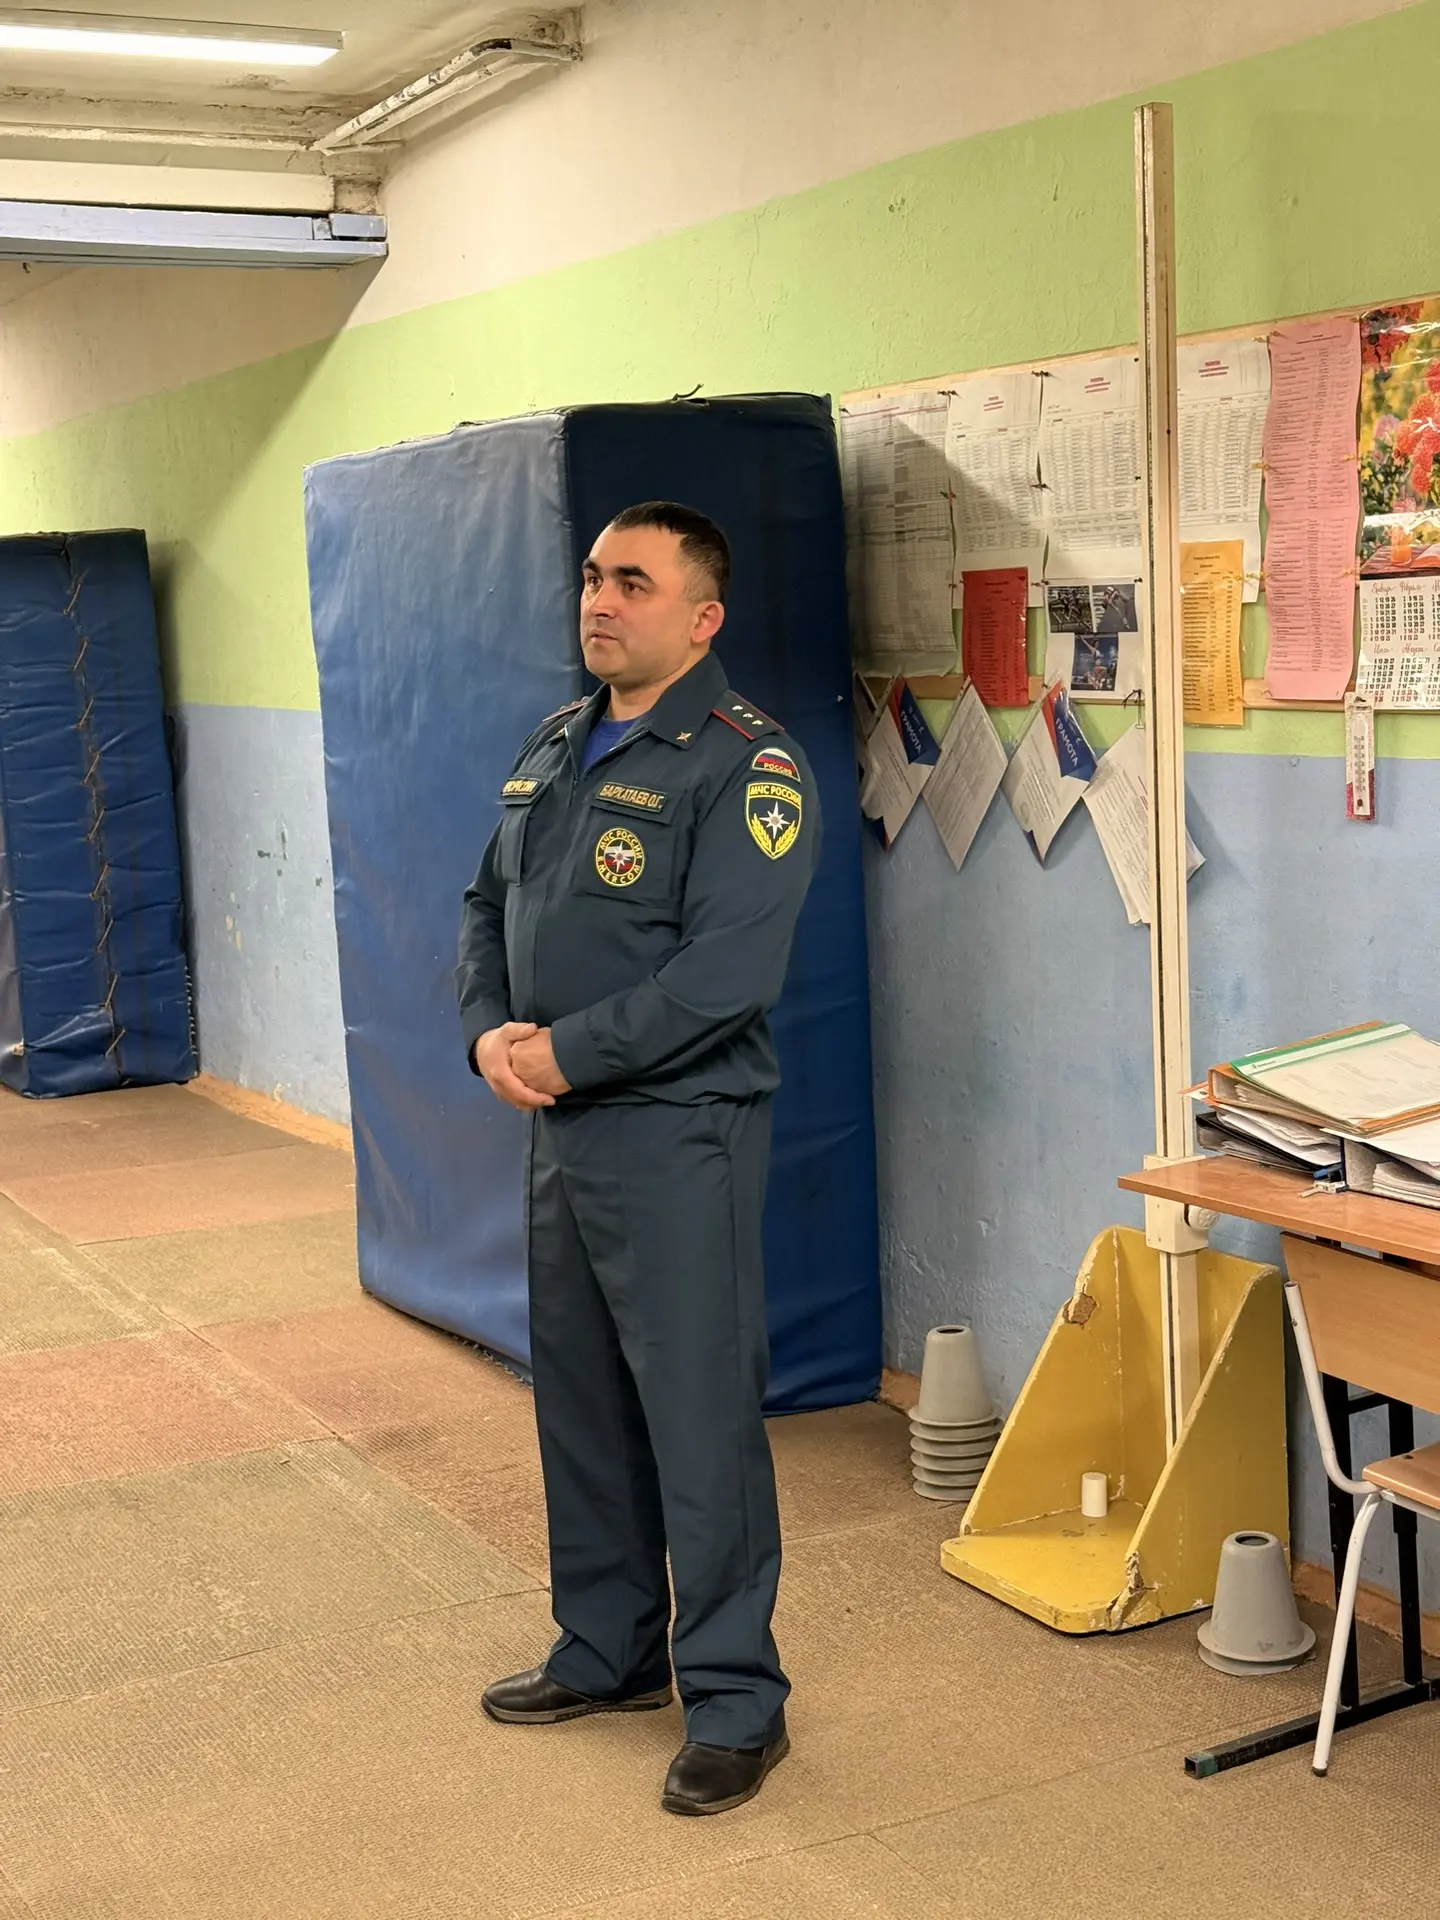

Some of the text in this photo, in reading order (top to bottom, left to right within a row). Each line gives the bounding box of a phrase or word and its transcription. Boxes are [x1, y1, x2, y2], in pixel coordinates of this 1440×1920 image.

[901, 710, 922, 754] ГРАМОТА
[1056, 717, 1079, 767] ГРАМОТА
[750, 784, 770, 795] МЧС
[600, 830, 643, 859] МЧС РОССИИ
